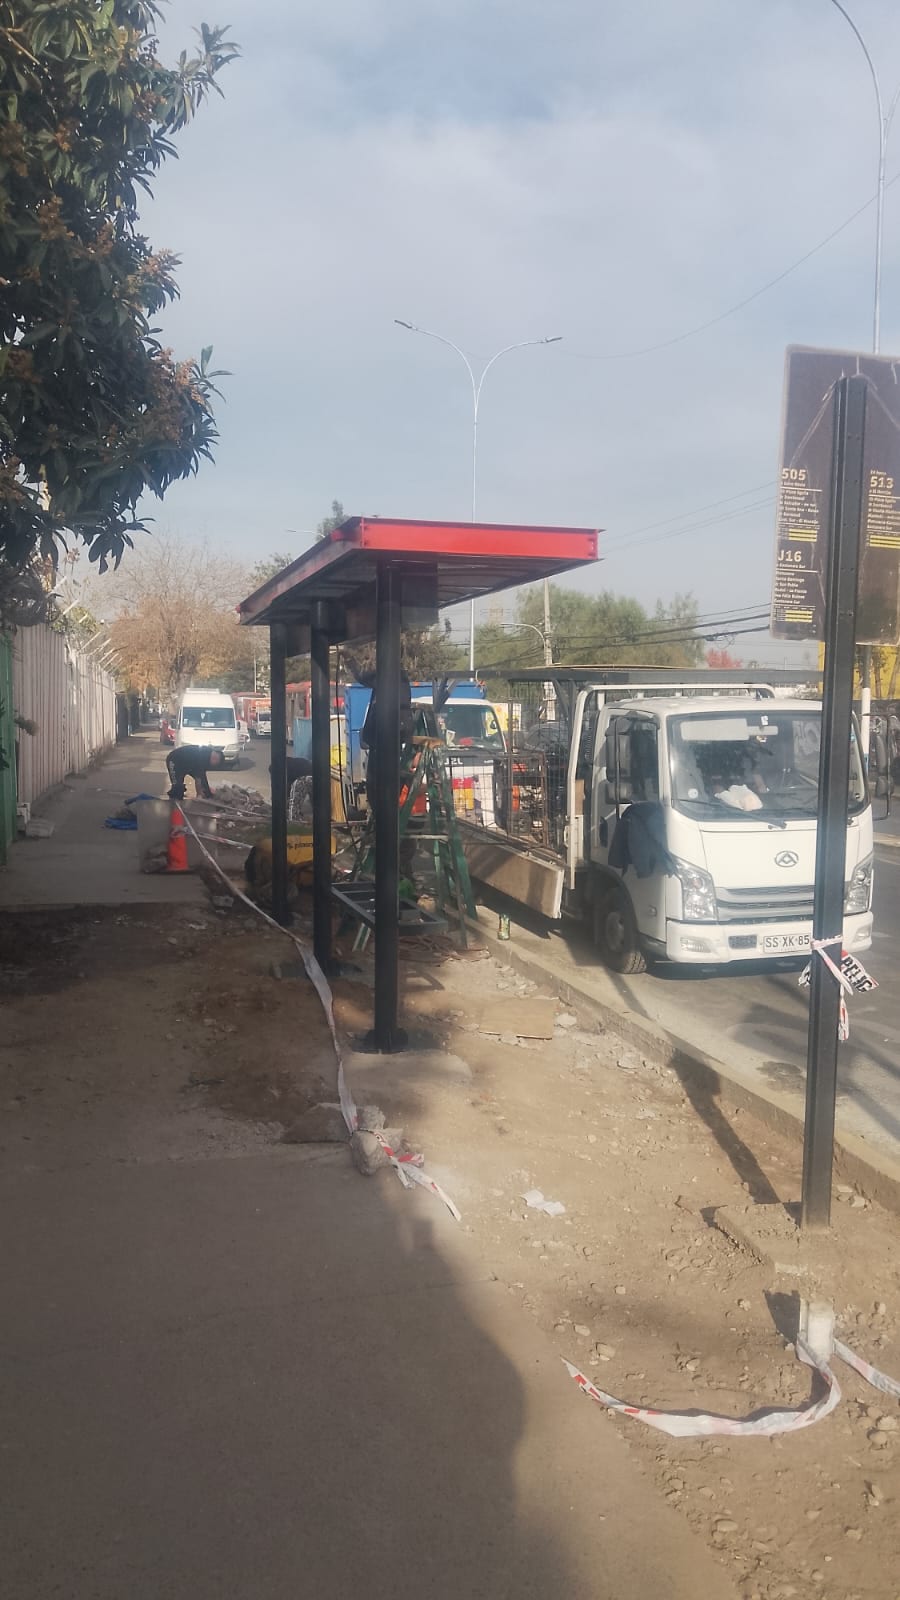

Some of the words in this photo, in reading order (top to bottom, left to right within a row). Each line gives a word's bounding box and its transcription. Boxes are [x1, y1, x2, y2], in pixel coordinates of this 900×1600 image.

[782, 468, 806, 480] 505
[870, 476, 893, 488] 513
[778, 550, 802, 562] J16
[765, 938, 778, 947] SS
[798, 935, 810, 945] 85
